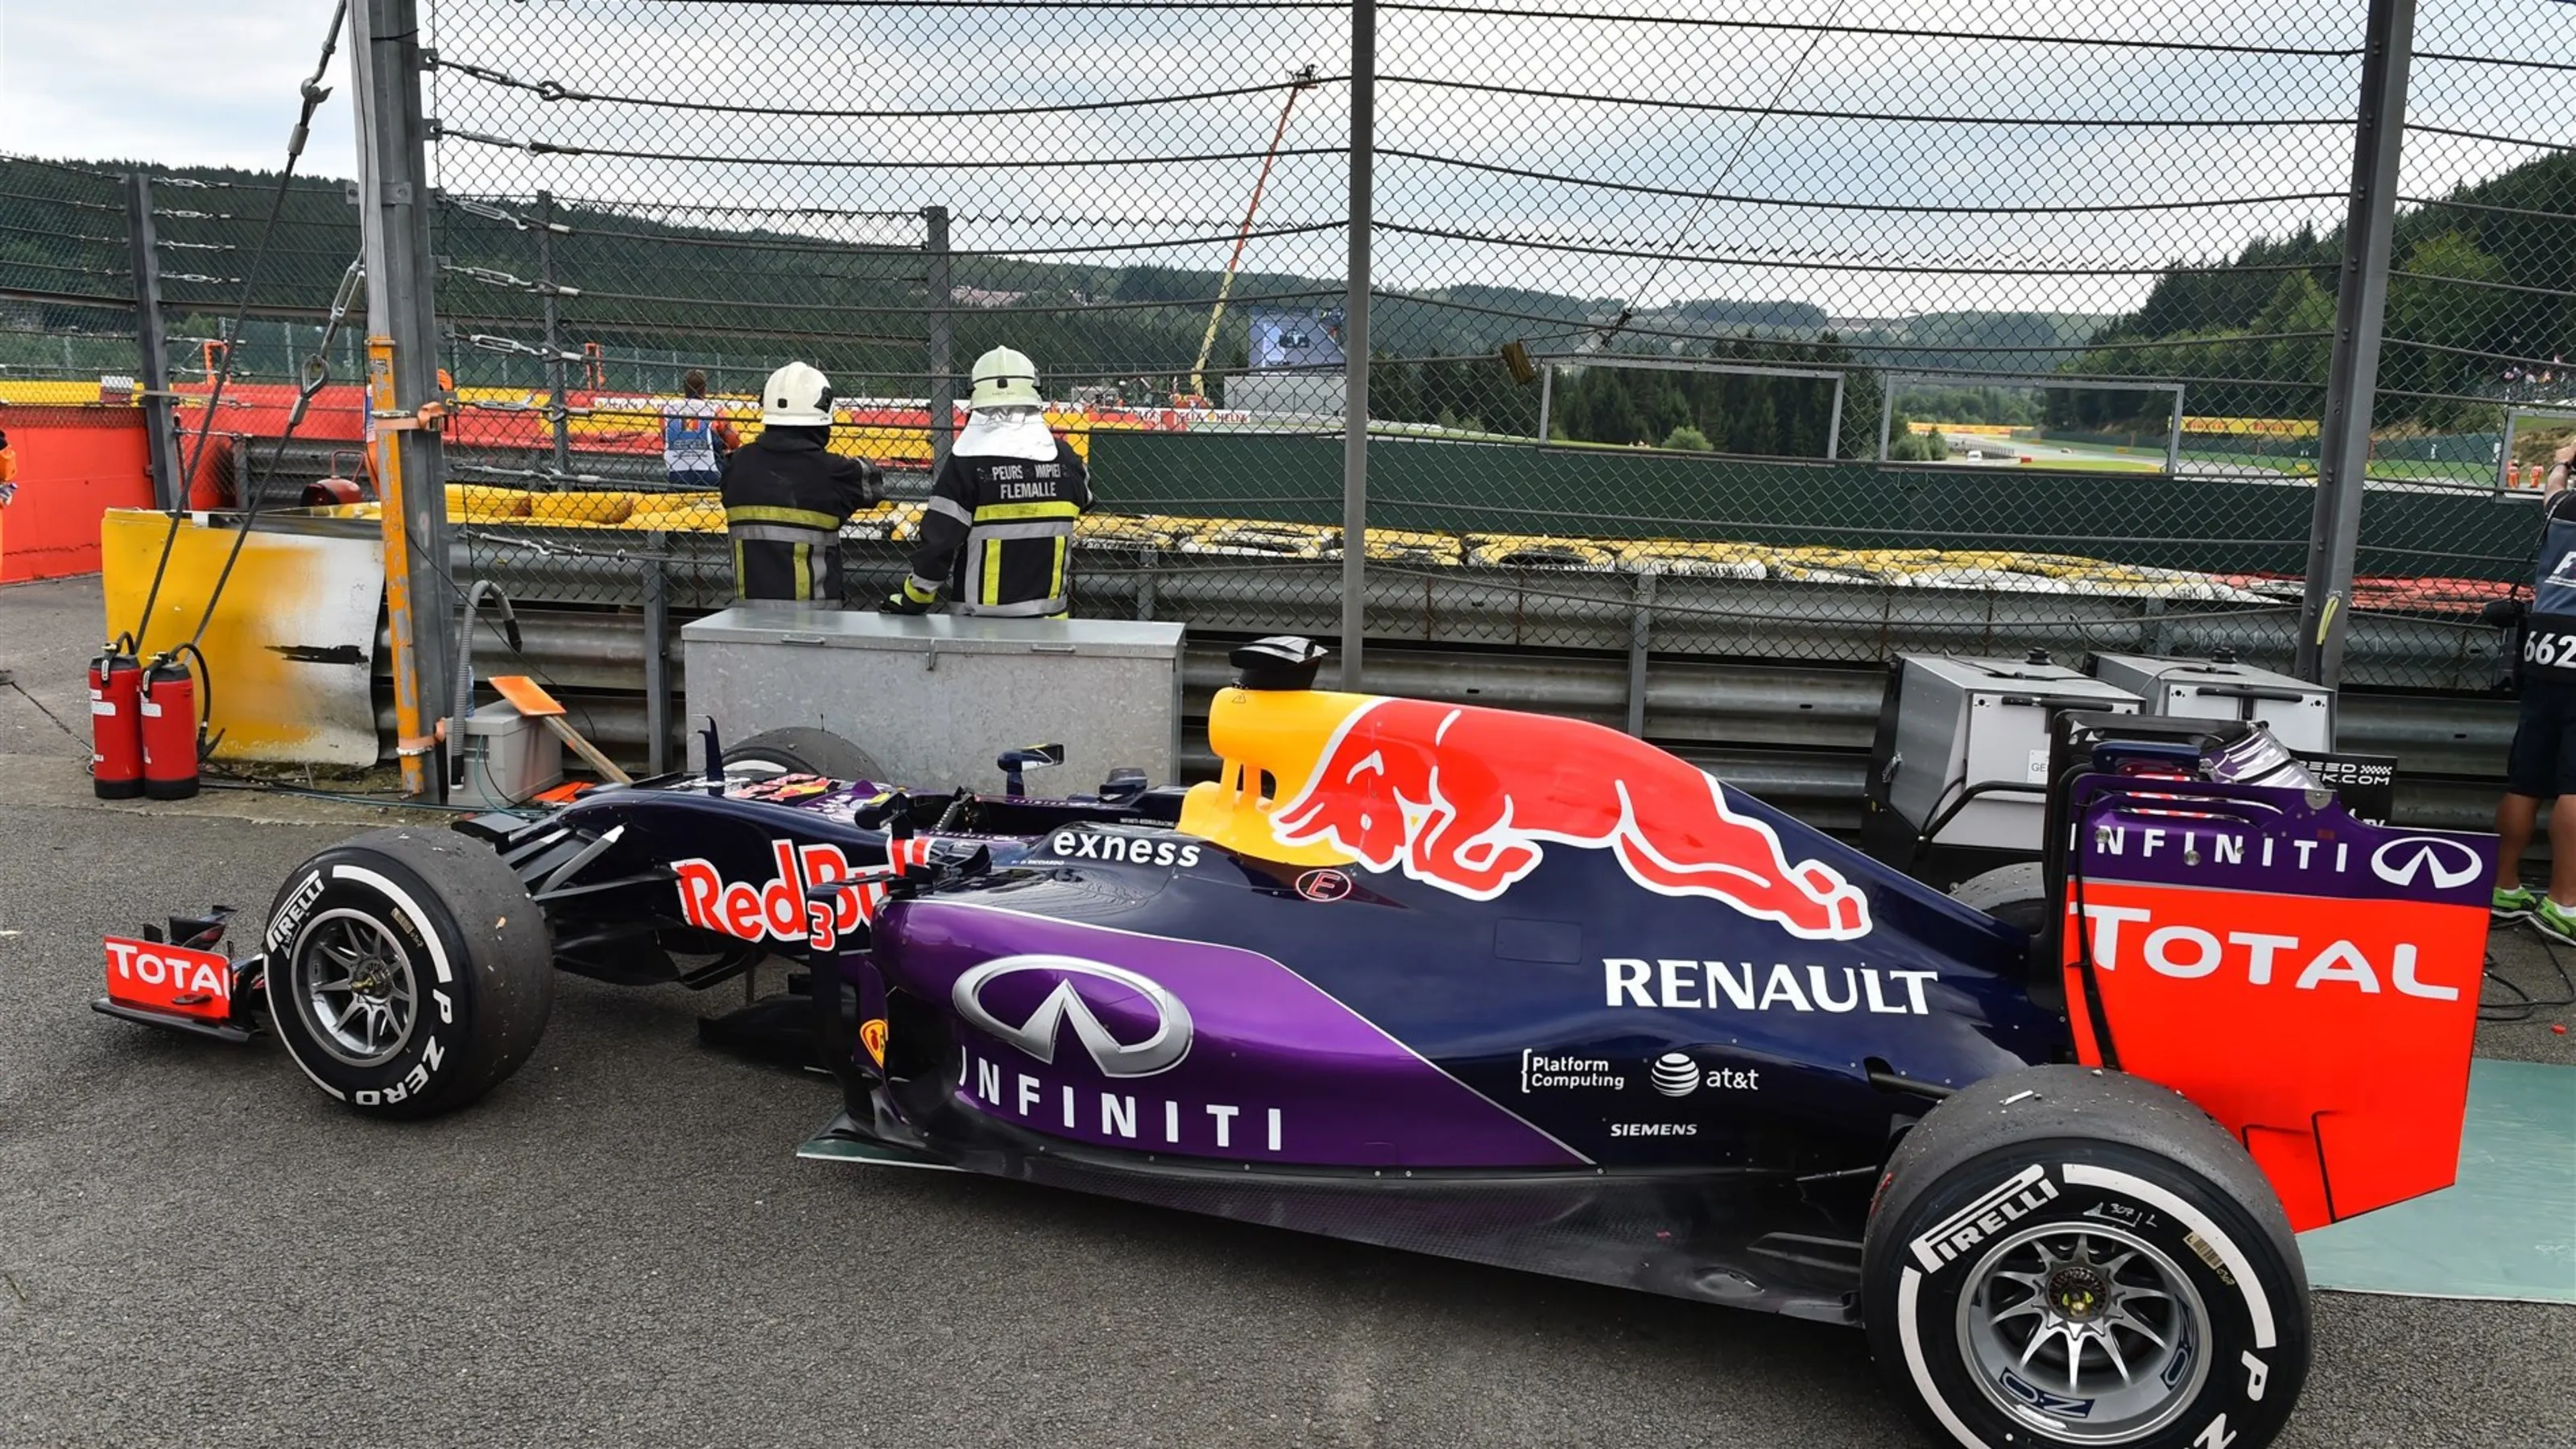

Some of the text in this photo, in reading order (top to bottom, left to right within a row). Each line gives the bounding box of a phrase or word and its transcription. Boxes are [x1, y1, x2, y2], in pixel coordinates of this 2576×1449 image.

[1000, 482, 1056, 499] FLEMALLE
[2524, 631, 2576, 669] 662
[1053, 832, 1201, 867] exness
[2070, 824, 2348, 873] INFINITI
[267, 869, 325, 952] PIRELLI
[808, 901, 835, 952] 3
[2069, 902, 2458, 1001] TOTAL
[1602, 958, 1937, 1015] RENAULT
[355, 989, 453, 1106] P ZERO
[1532, 1056, 1609, 1072] Platform
[1532, 1073, 1625, 1090] Computing
[1706, 1067, 1759, 1090] at&t
[1610, 1123, 1698, 1137] SIEMENS
[1909, 1164, 2059, 1274] PIRELLI
[2241, 1350, 2268, 1402] P
